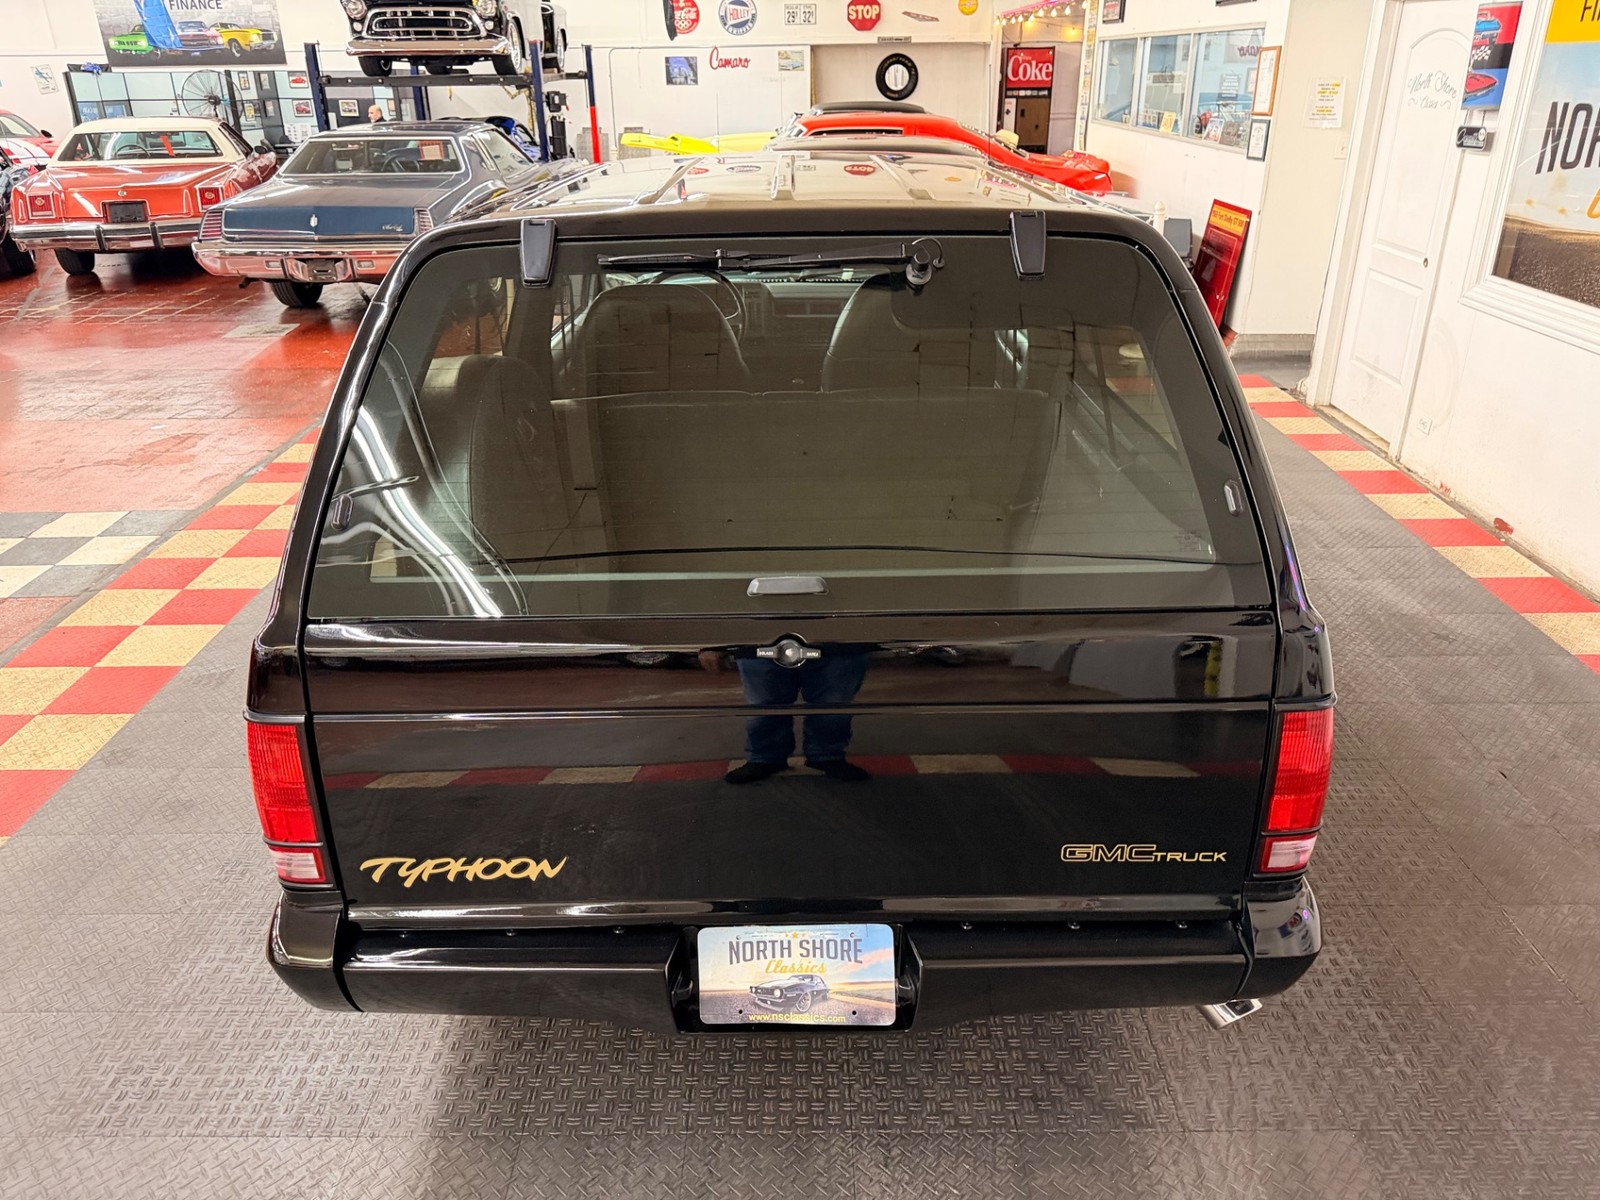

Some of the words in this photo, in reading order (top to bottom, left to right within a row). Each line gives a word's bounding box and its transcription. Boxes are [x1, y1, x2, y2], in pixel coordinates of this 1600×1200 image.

[169, 0, 223, 10] FINANCE
[848, 5, 879, 20] STOP
[1580, 0, 1600, 22] FI
[729, 7, 750, 22] HOLLEY
[709, 46, 751, 70] Camaro
[1007, 55, 1053, 81] Coke
[1061, 844, 1156, 862] GMC
[1153, 852, 1227, 862] TRUCK
[360, 857, 568, 888] TYPHOON
[728, 939, 792, 965] NORTH
[799, 938, 863, 963] SHORE
[764, 959, 826, 974] Classics
[748, 1013, 846, 1023] www.nsclassics.com
